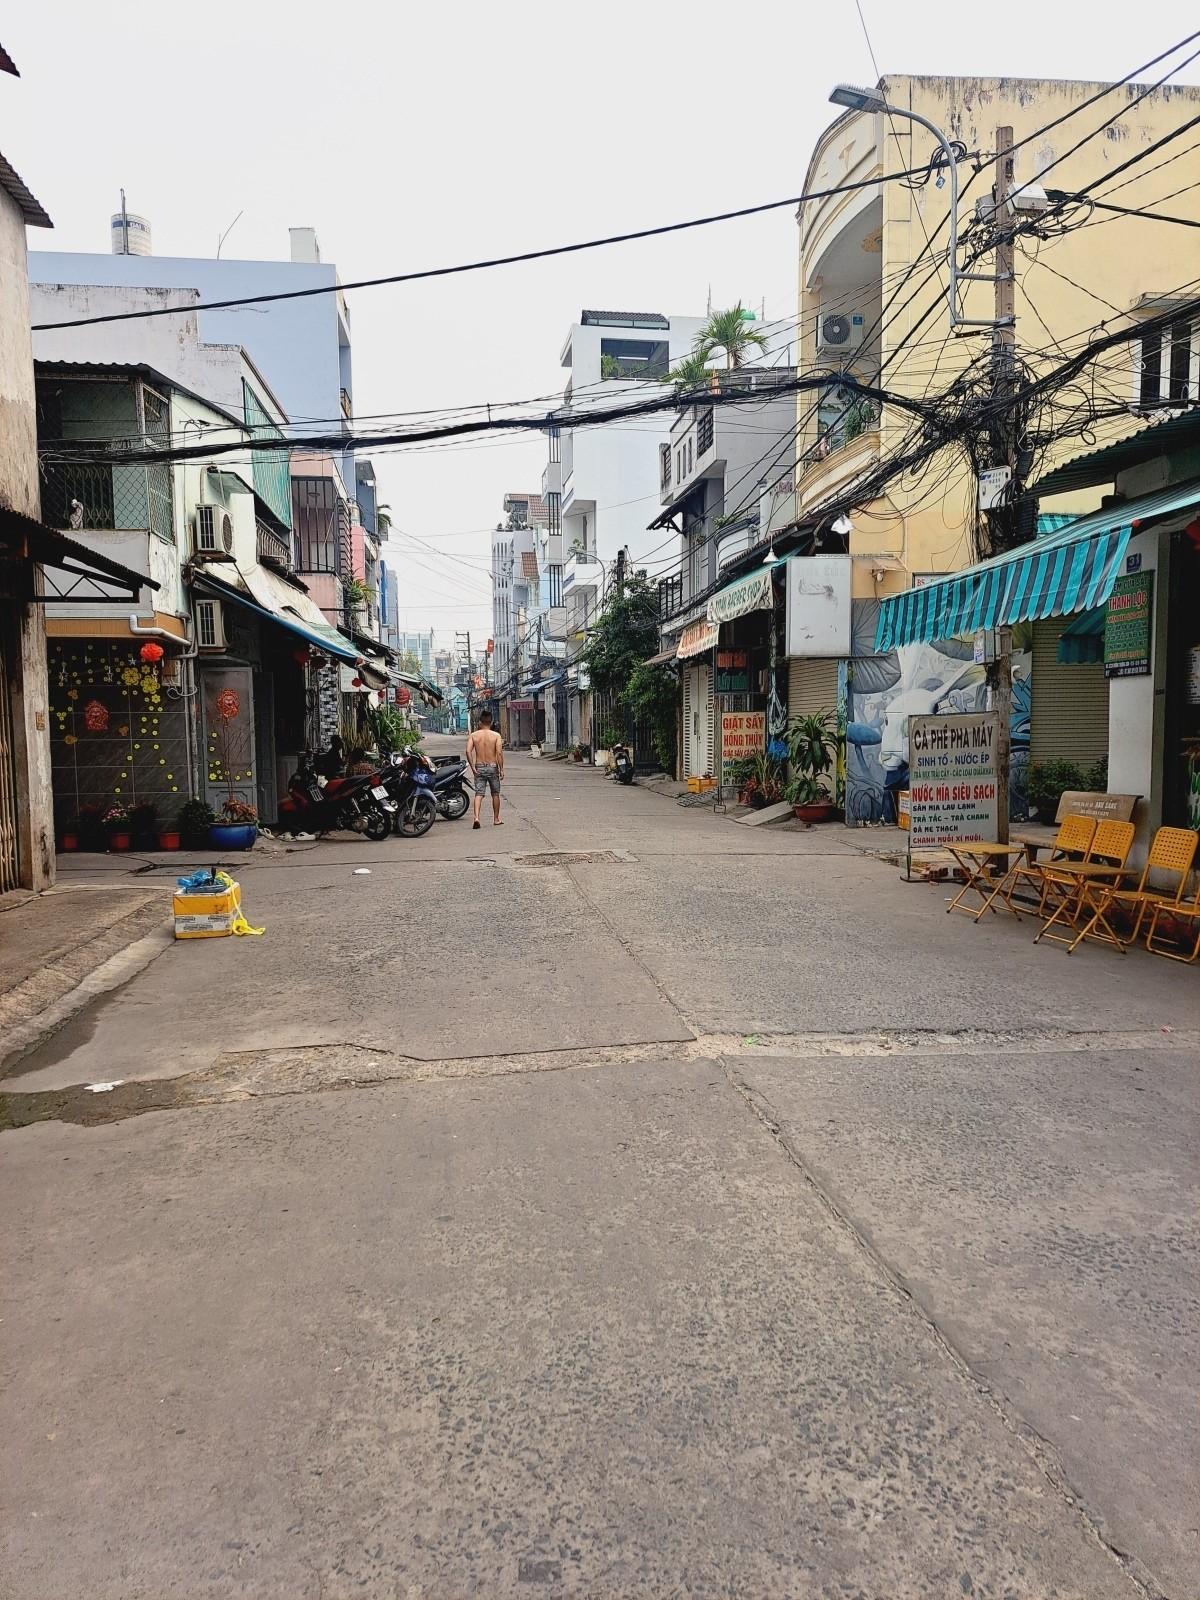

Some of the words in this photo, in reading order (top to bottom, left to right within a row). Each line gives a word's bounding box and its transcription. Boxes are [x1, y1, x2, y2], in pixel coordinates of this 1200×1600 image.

[723, 716, 744, 732] GIẶT
[746, 713, 764, 729] SẤY
[914, 723, 929, 751] CÀ
[930, 723, 948, 750] PHÊ
[950, 727, 970, 749] PHA
[972, 720, 993, 748] MÁY
[917, 756, 936, 767] SINH
[938, 752, 949, 766] TỐ
[954, 752, 979, 765] NƯỚC
[980, 751, 990, 764] ÉP
[912, 782, 933, 803] NƯỚC
[936, 783, 949, 802] MÍA
[952, 782, 971, 801] SIÊU
[973, 784, 995, 803] SẠCH
[951, 812, 964, 821] TRÀ
[966, 813, 990, 821] CHANH
[912, 836, 936, 844] CHANH
